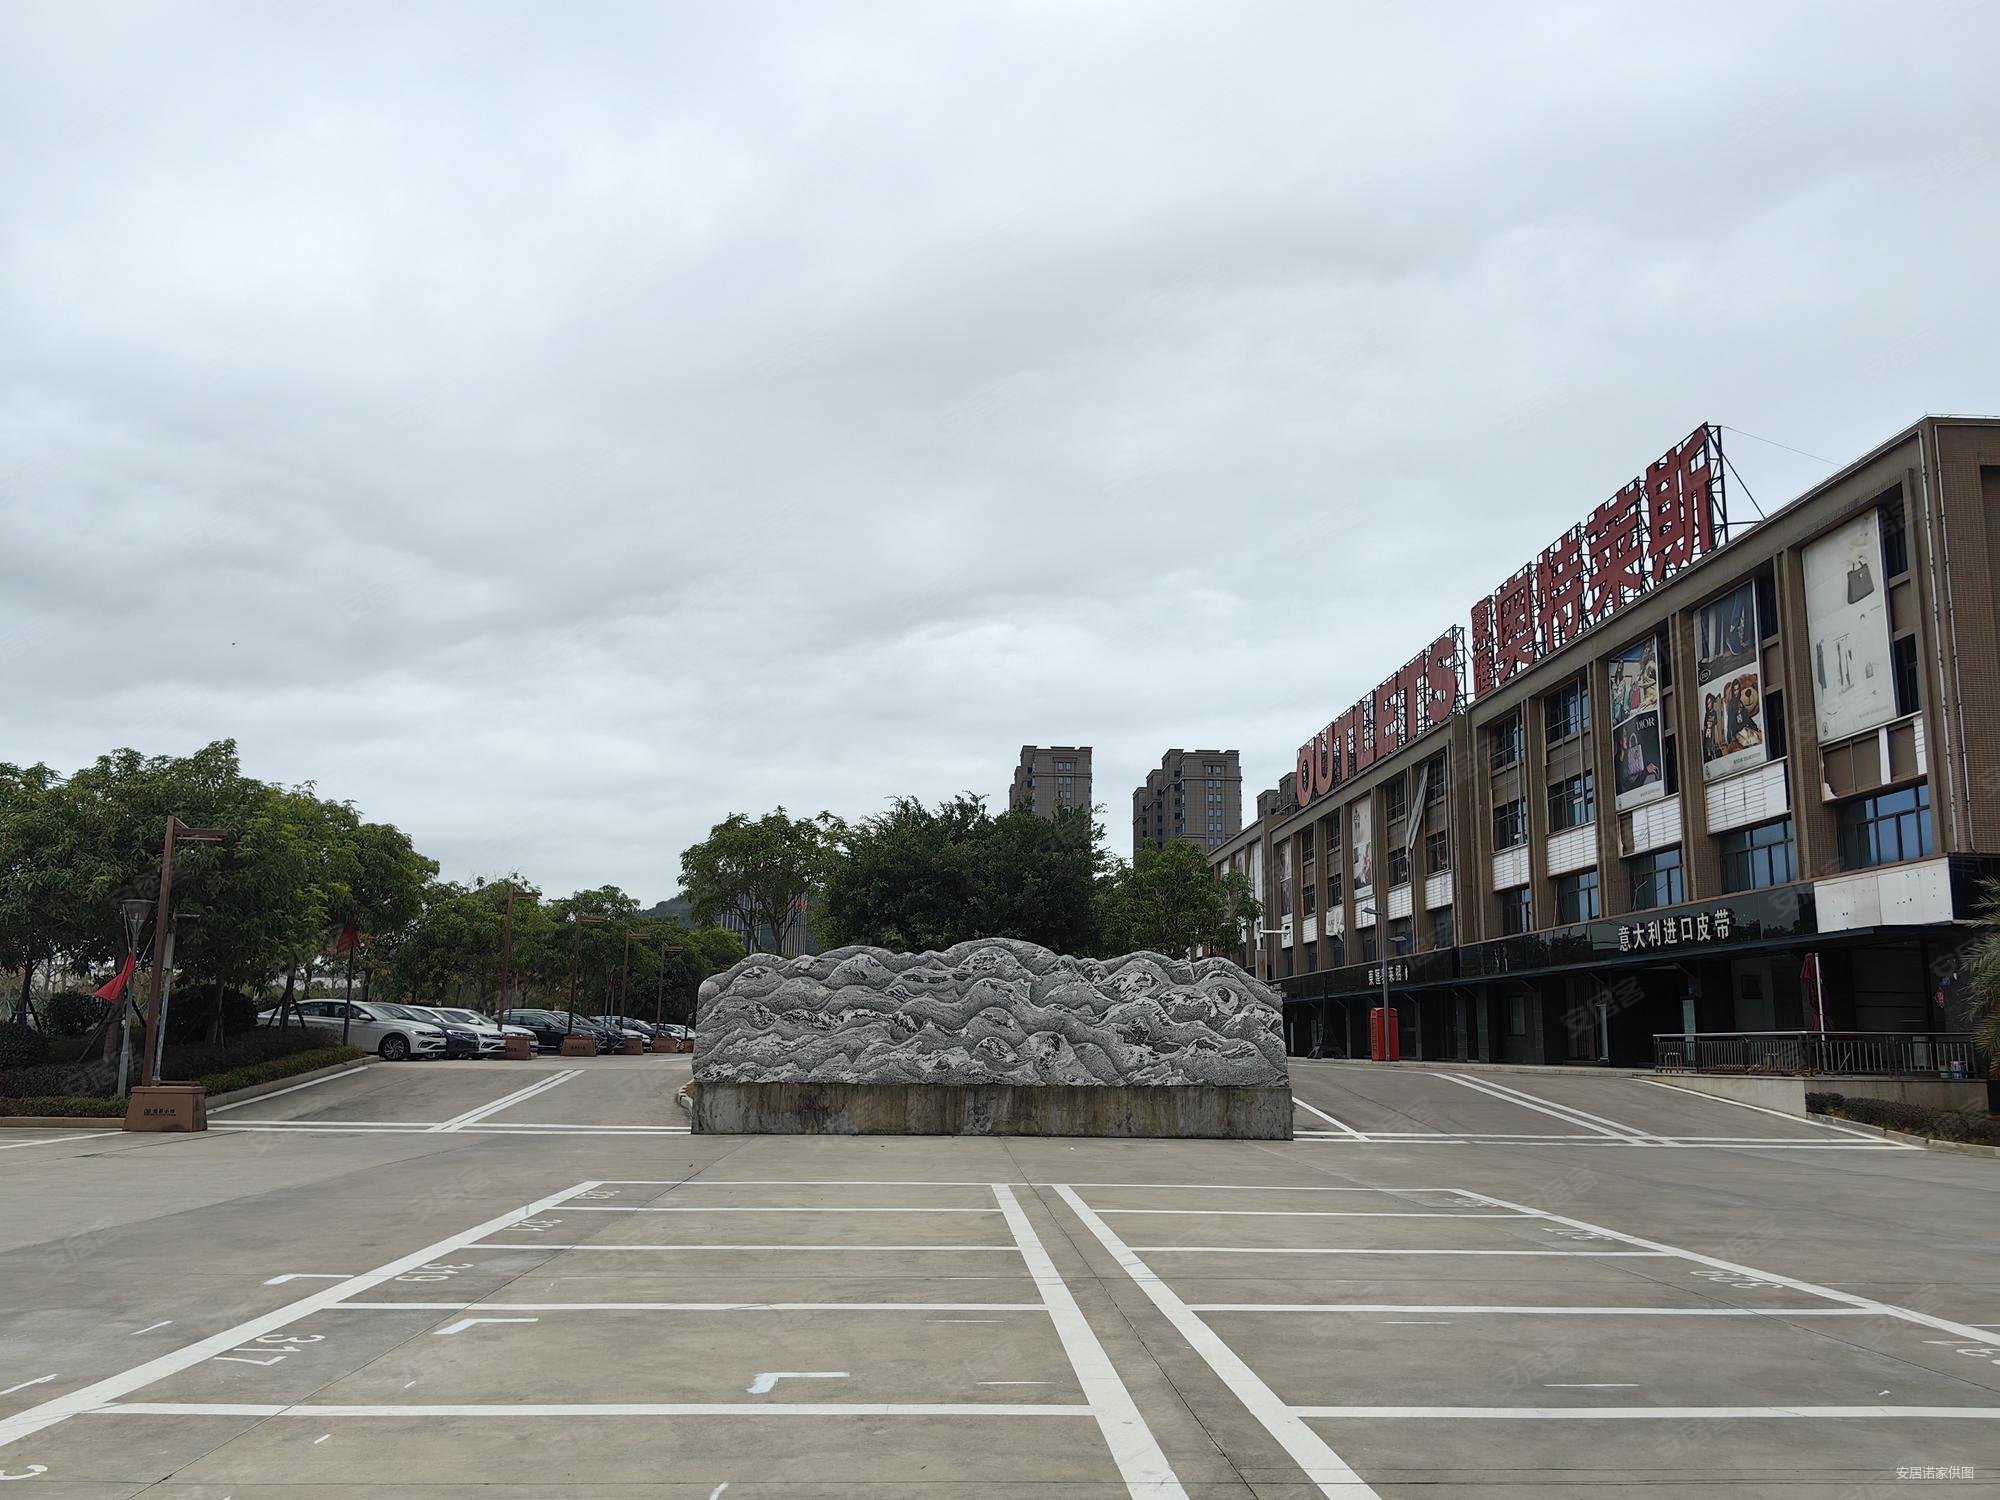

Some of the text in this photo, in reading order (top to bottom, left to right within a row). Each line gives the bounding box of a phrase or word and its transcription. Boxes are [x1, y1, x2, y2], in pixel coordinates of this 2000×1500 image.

[1297, 636, 1458, 807] OUTLETS
[1636, 716, 1656, 731] DIOR
[1618, 908, 1730, 952] 意大利进口皮带
[504, 1218, 563, 1232] 321
[394, 1263, 474, 1282] 319
[1690, 1271, 1784, 1289] 329
[213, 1334, 326, 1366] 317
